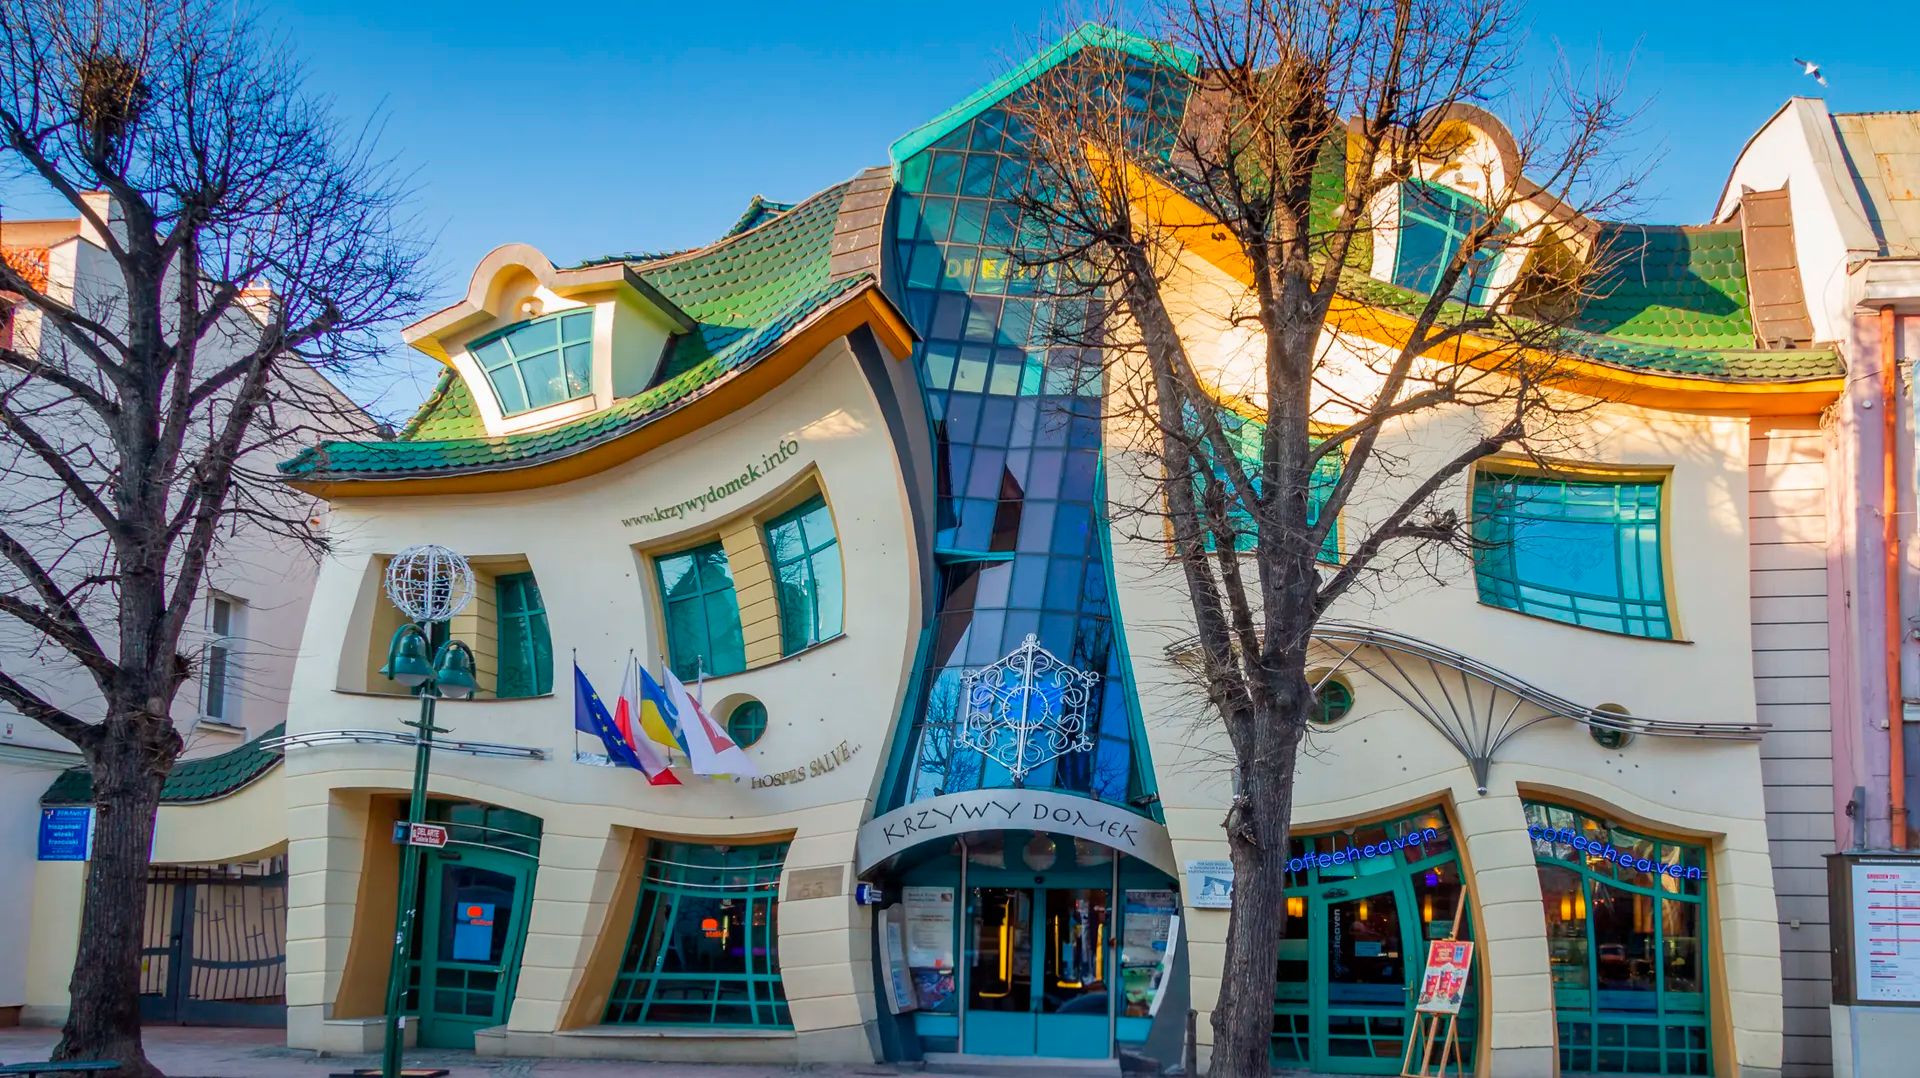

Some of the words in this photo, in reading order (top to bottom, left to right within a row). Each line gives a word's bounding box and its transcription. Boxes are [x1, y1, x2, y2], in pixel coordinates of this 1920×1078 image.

[621, 439, 800, 528] www.krzywydomek.info
[751, 766, 806, 789] HOSPES
[883, 800, 1021, 845] KRZYWY
[1033, 803, 1138, 847] DOMEK
[1528, 823, 1701, 880] coffeeheaven
